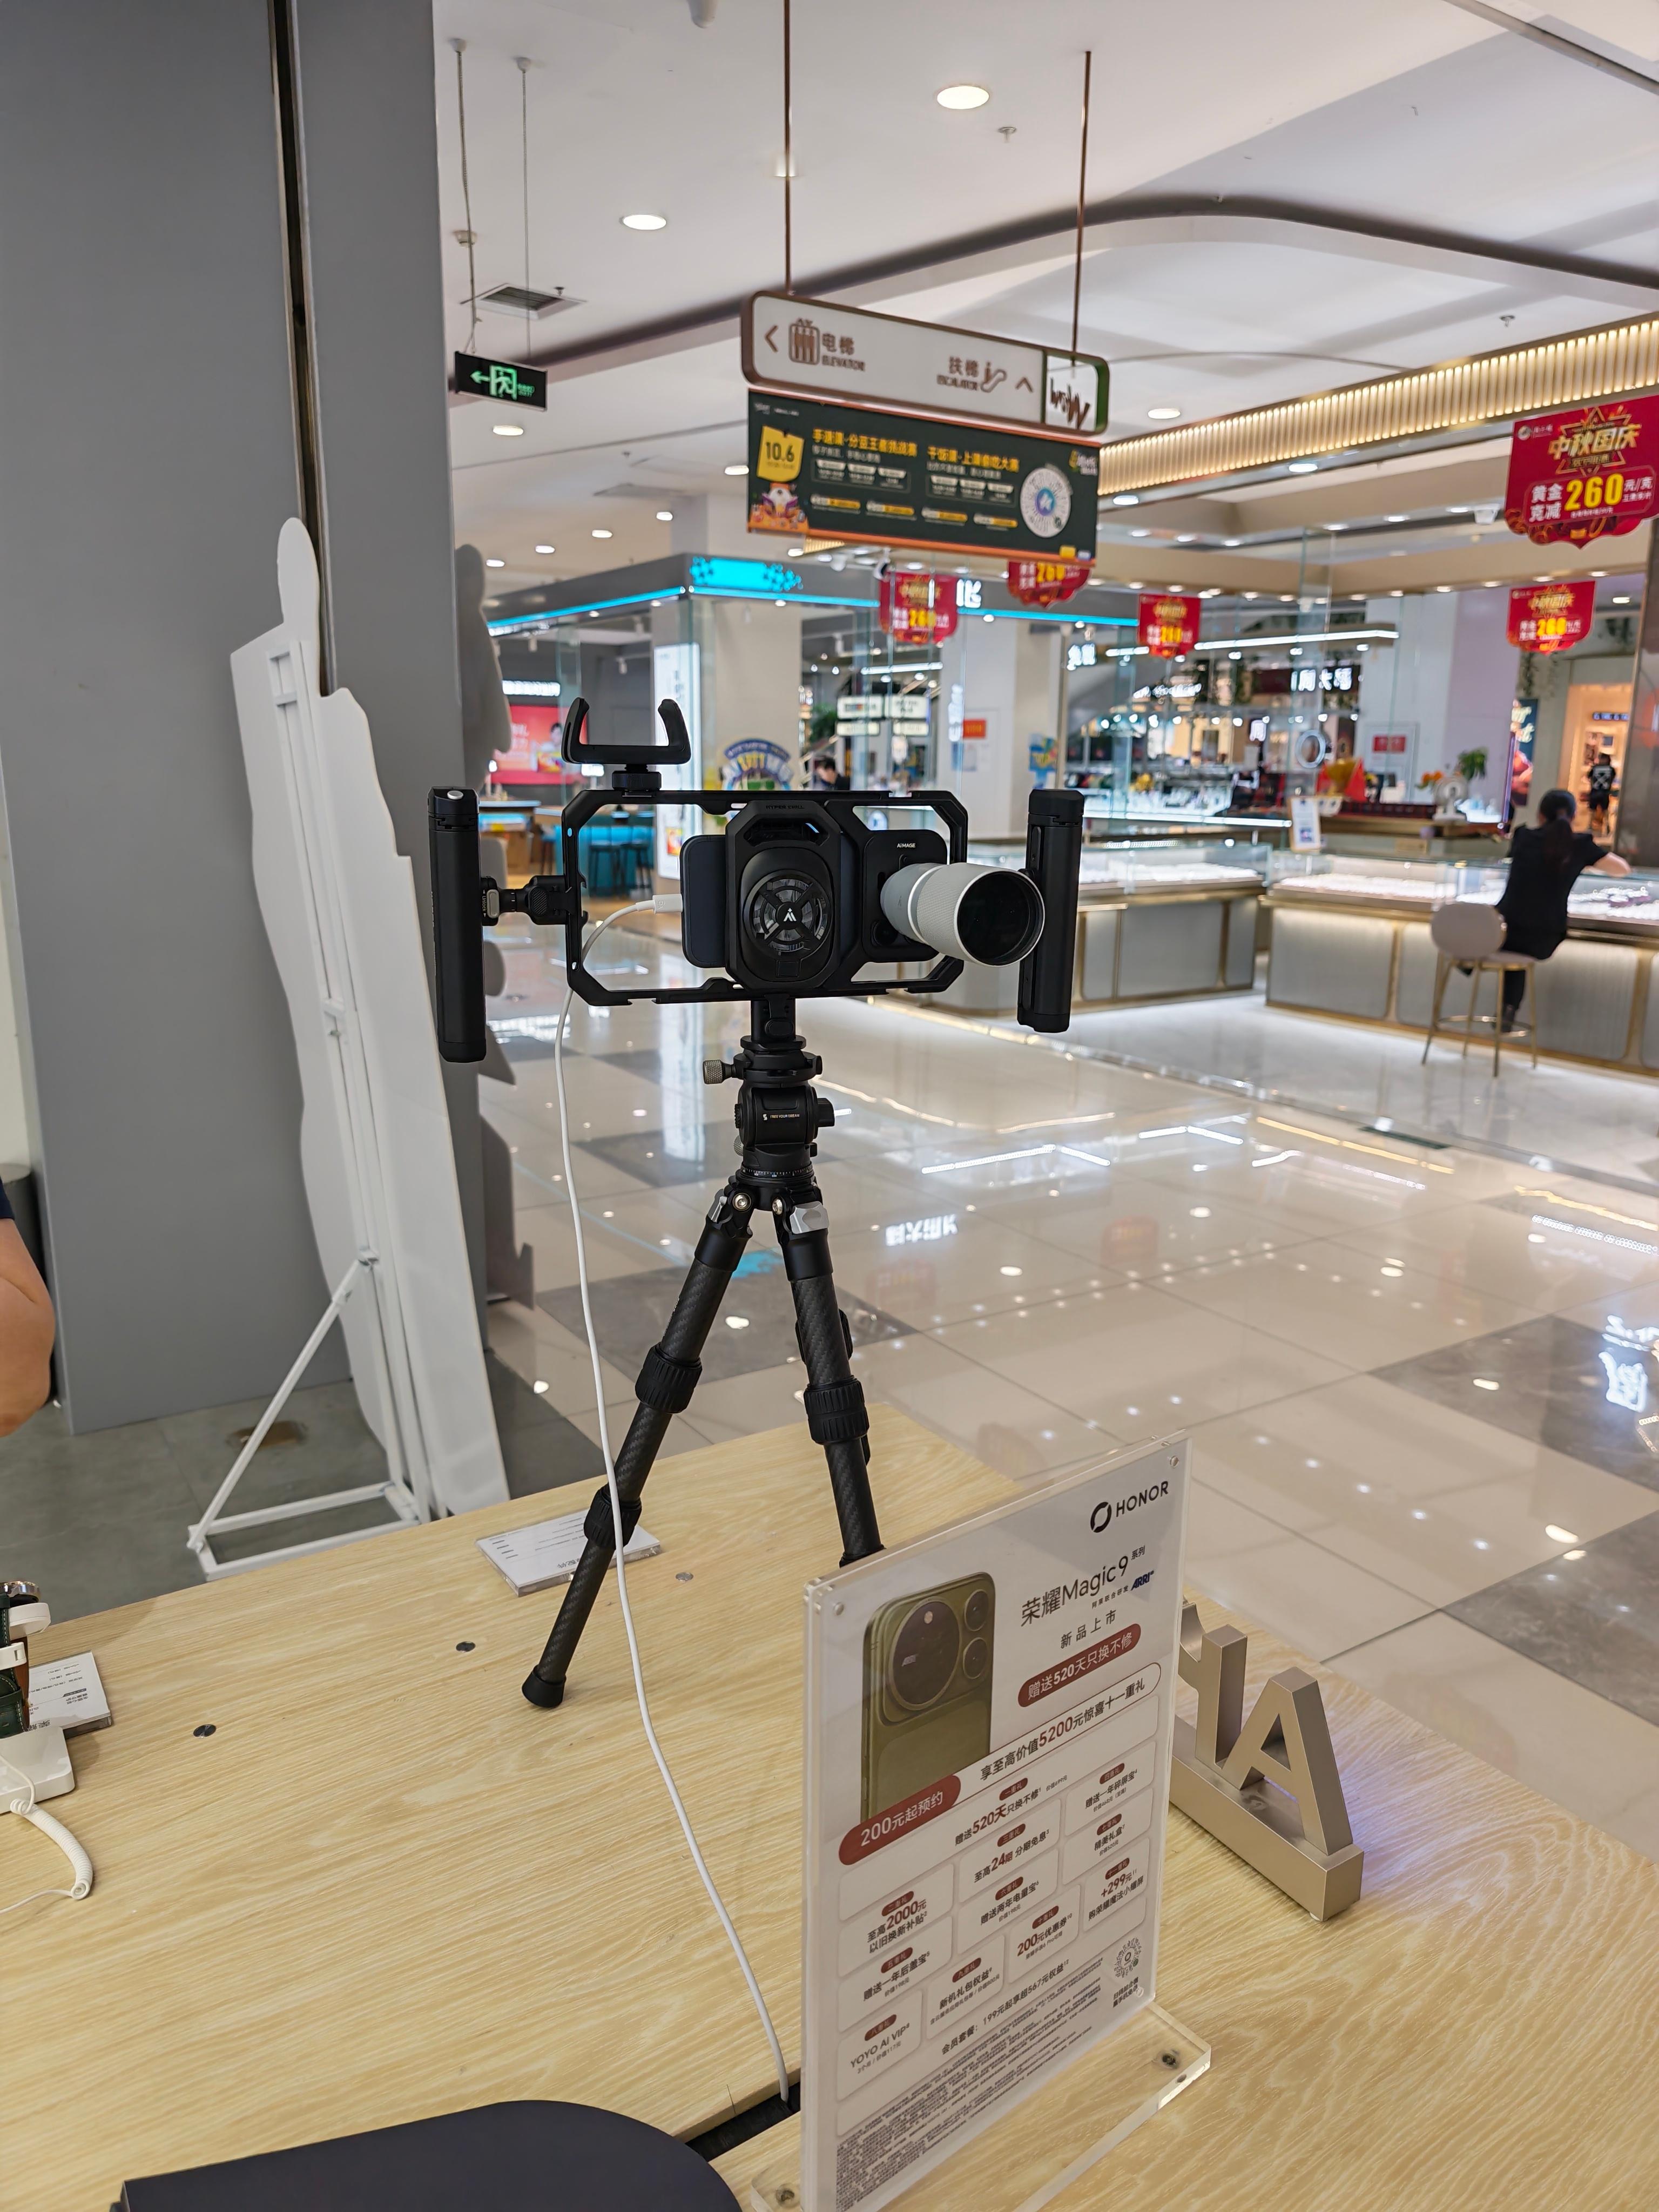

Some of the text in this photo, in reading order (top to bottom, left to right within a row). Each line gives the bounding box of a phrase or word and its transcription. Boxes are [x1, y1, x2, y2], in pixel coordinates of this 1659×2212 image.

[822, 333, 855, 355] 电梯
[822, 355, 866, 372] ELEVATOR
[949, 356, 979, 377] 扶梯
[766, 442, 795, 462] 10.6
[1548, 424, 1642, 460] 中秋国庆
[1532, 483, 1563, 503] 黄金
[1564, 473, 1624, 511] 260
[1116, 1480, 1169, 1518] HONOR
[1061, 1609, 1116, 1649] 新品上市
[1027, 1632, 1132, 1700] 赠送520天只换不修
[980, 1677, 1145, 1782] 享至高价值5200元惊喜十一重礼
[860, 1791, 943, 1847] 200元起预约
[974, 1851, 1013, 1883] 至高24期
[867, 1899, 927, 1943] 至高2000元
[851, 2045, 878, 2068] YOYO
[880, 2036, 889, 2049] AI
